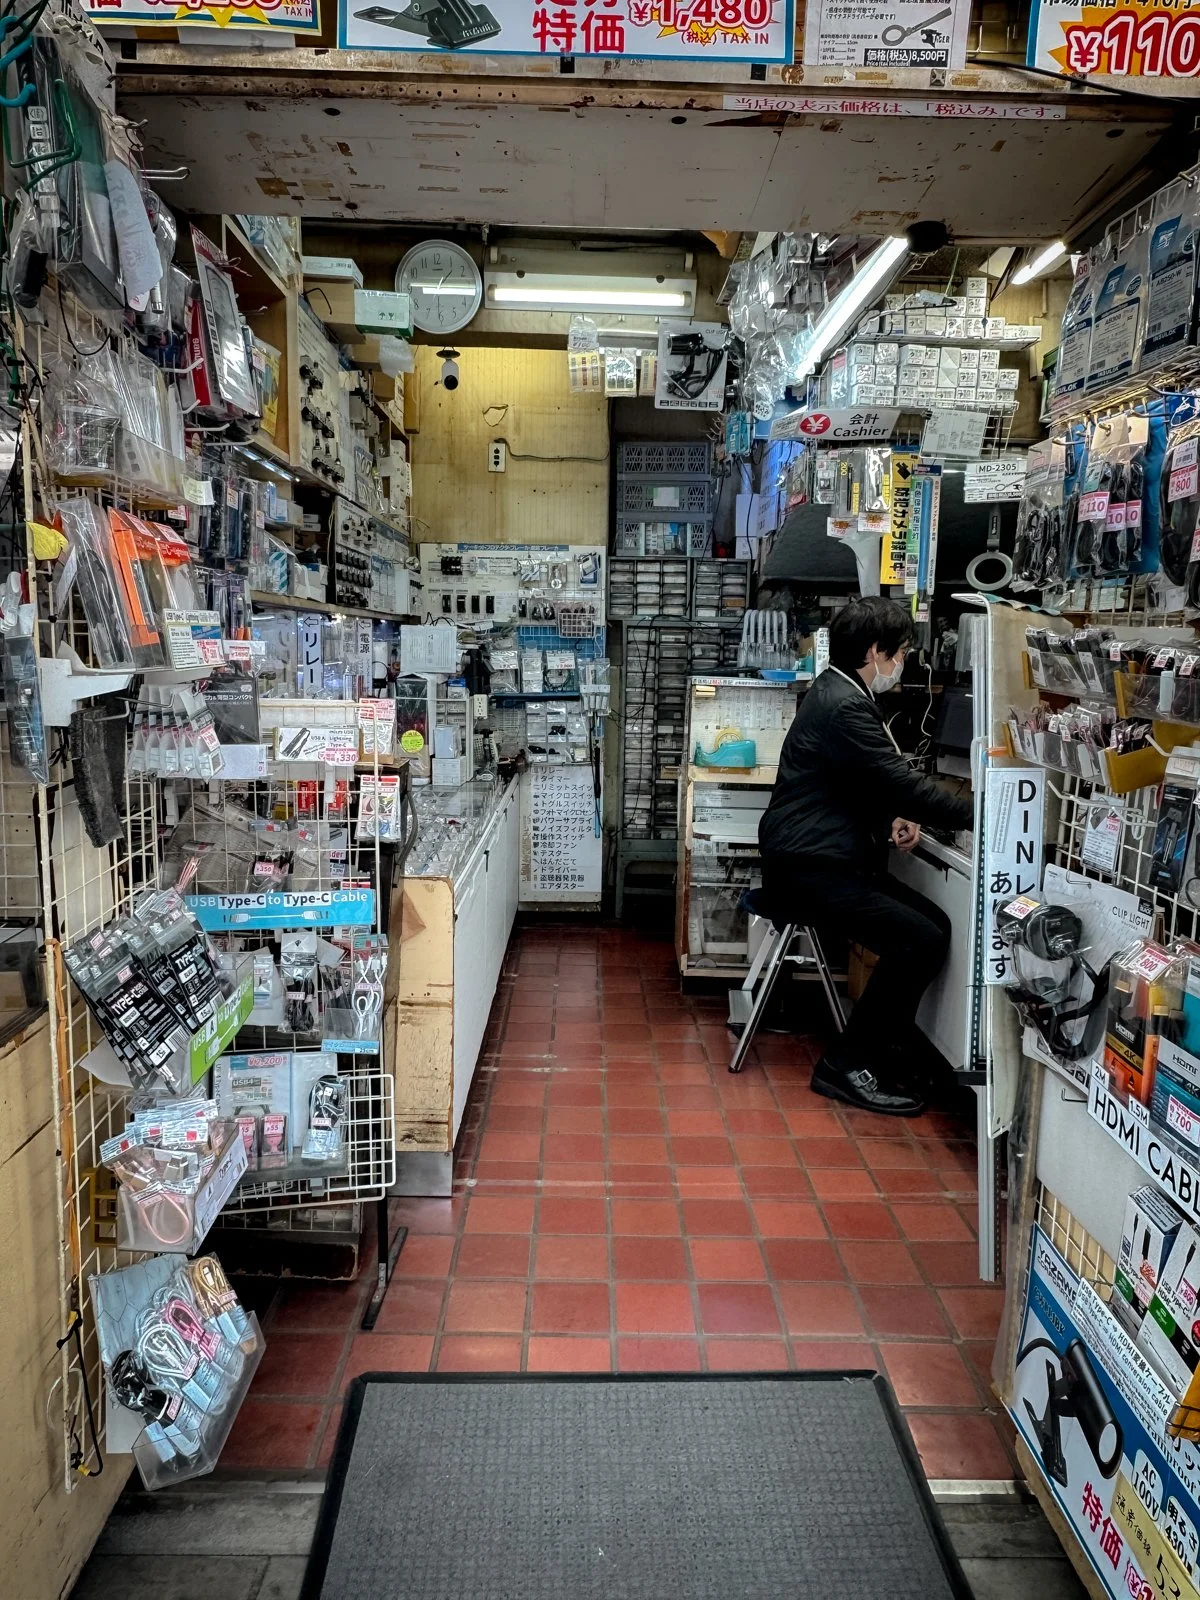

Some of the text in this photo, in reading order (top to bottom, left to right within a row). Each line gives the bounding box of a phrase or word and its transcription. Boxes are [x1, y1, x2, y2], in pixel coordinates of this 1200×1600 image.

[532, 8, 625, 53] 特価
[721, 32, 751, 44] TAX
[754, 33, 769, 44] IN
[1068, 10, 1200, 76] ¥110
[866, 50, 946, 62] 価格(税込)8,500円
[735, 97, 1061, 119] 当店の表示価格は、「税込み」です。
[421, 257, 427, 268] 11
[434, 253, 441, 265] 12
[411, 268, 418, 278] 10
[459, 266, 466, 277] 2
[414, 298, 419, 310] 8
[850, 413, 880, 425] 会計
[833, 426, 888, 438] Cashier
[978, 464, 1016, 473] MD-2305
[1175, 480, 1192, 492] 800
[1087, 500, 1105, 513] 110
[360, 632, 370, 654] 電源
[305, 632, 320, 684] リレー
[190, 891, 368, 908] USB Type-C to Type-C Cable
[990, 870, 1013, 979] あます
[1112, 906, 1150, 931] CLIP LIGHT
[194, 1029, 206, 1052] USB
[210, 1022, 215, 1036] A
[1094, 1066, 1106, 1082] 2M
[1094, 1086, 1140, 1156] HDMI
[1130, 1100, 1148, 1124] 1.5M
[1175, 1114, 1192, 1132] 700
[1082, 1282, 1092, 1298] USB
[1092, 1296, 1113, 1323] Type-C
[1161, 1278, 1172, 1296] USB
[1171, 1288, 1188, 1318] Type-C
[1108, 1334, 1122, 1352] HDMI
[1121, 1352, 1152, 1392] conversion
[1152, 1395, 1168, 1417] cable
[1142, 1462, 1156, 1489] AC
[1134, 1472, 1159, 1518] 100V
[1082, 1480, 1124, 1571] 特価
[1168, 1500, 1198, 1552] 明るさ
